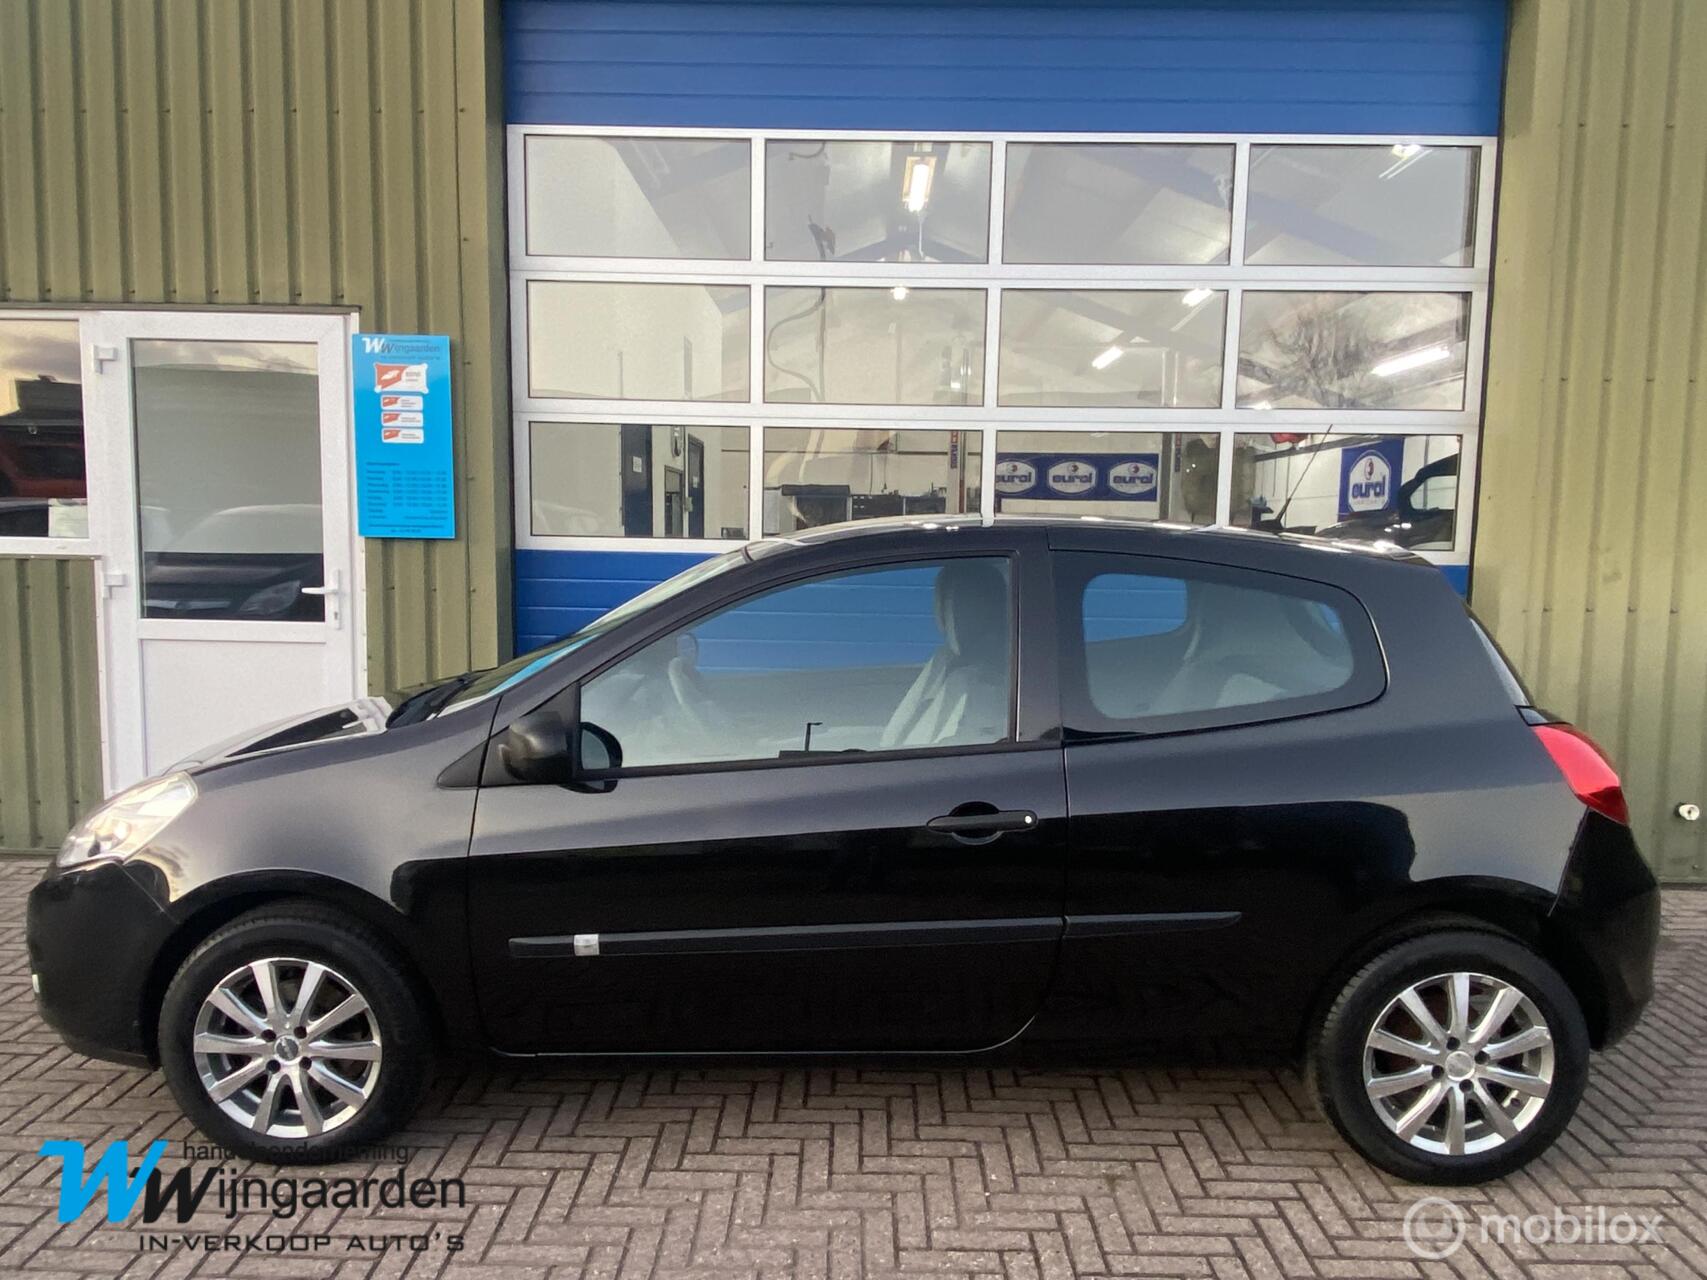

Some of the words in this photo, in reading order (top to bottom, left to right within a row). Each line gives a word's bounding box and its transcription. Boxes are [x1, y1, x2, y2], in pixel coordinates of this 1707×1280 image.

[1052, 472, 1093, 484] eurol
[1112, 473, 1154, 485] eurol
[1351, 475, 1386, 498] eurol
